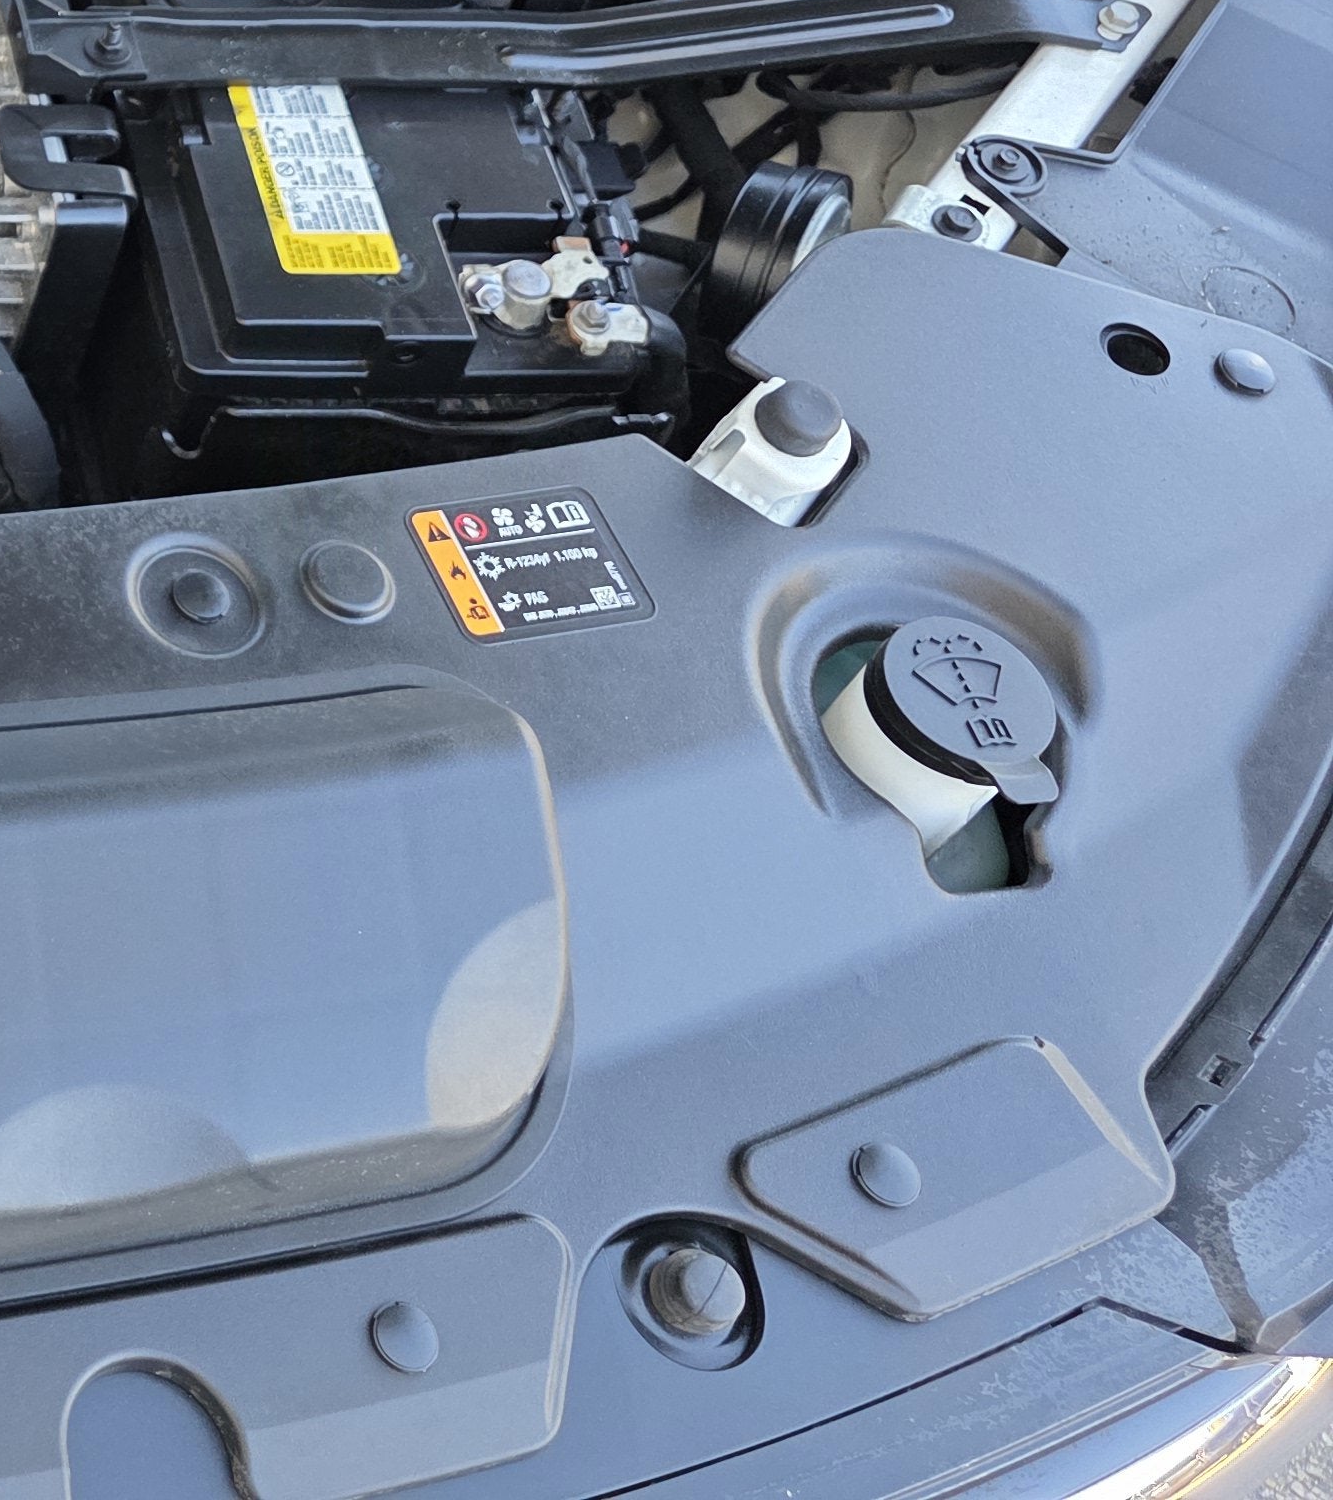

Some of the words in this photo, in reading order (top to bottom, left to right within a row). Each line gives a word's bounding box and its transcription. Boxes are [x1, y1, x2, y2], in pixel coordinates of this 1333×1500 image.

[247, 127, 268, 165] POISON
[259, 165, 281, 209] DANGER
[498, 524, 524, 538] AUTO
[581, 546, 599, 560] kg
[523, 590, 549, 606] PAG
